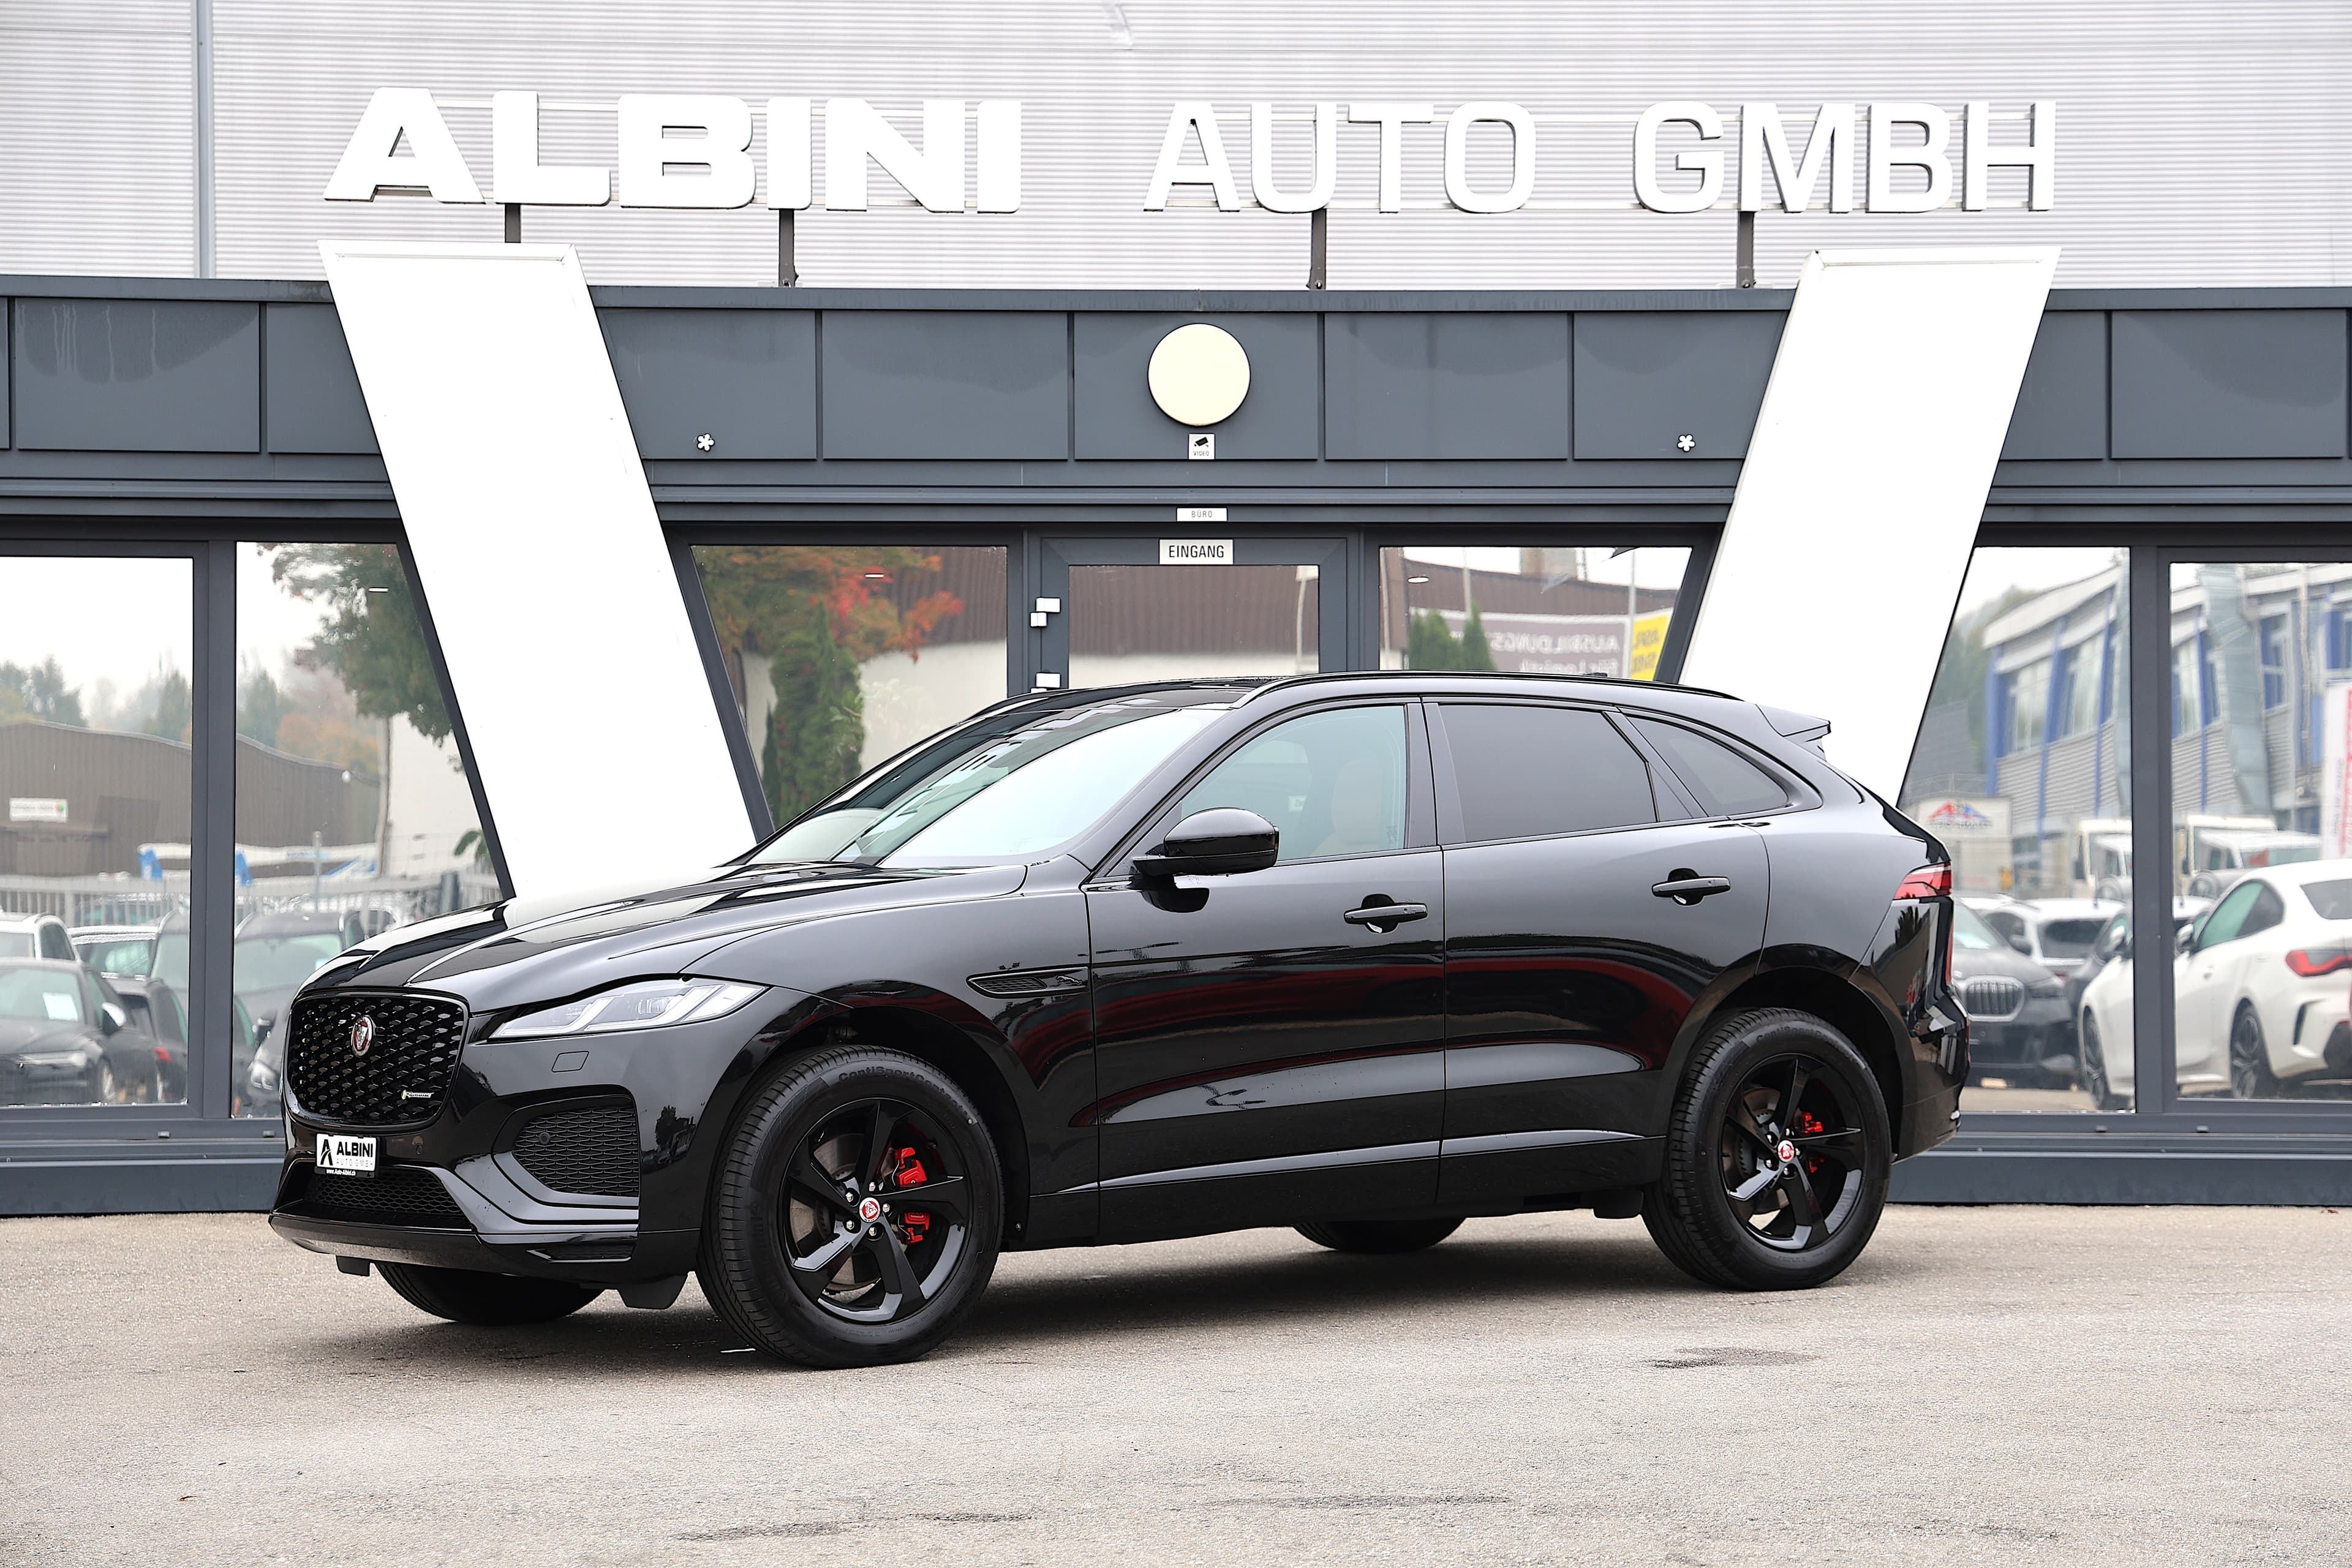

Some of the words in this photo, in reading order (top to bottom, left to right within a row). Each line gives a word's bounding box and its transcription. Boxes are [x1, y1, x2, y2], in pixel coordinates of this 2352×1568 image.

[322, 86, 1022, 213] ALBINI
[1144, 101, 1537, 214] AUTO
[1632, 100, 2056, 213] GMBH
[1191, 509, 1213, 518] BÜRO
[1168, 545, 1225, 558] EINGANG
[336, 1141, 374, 1158] ALBINI
